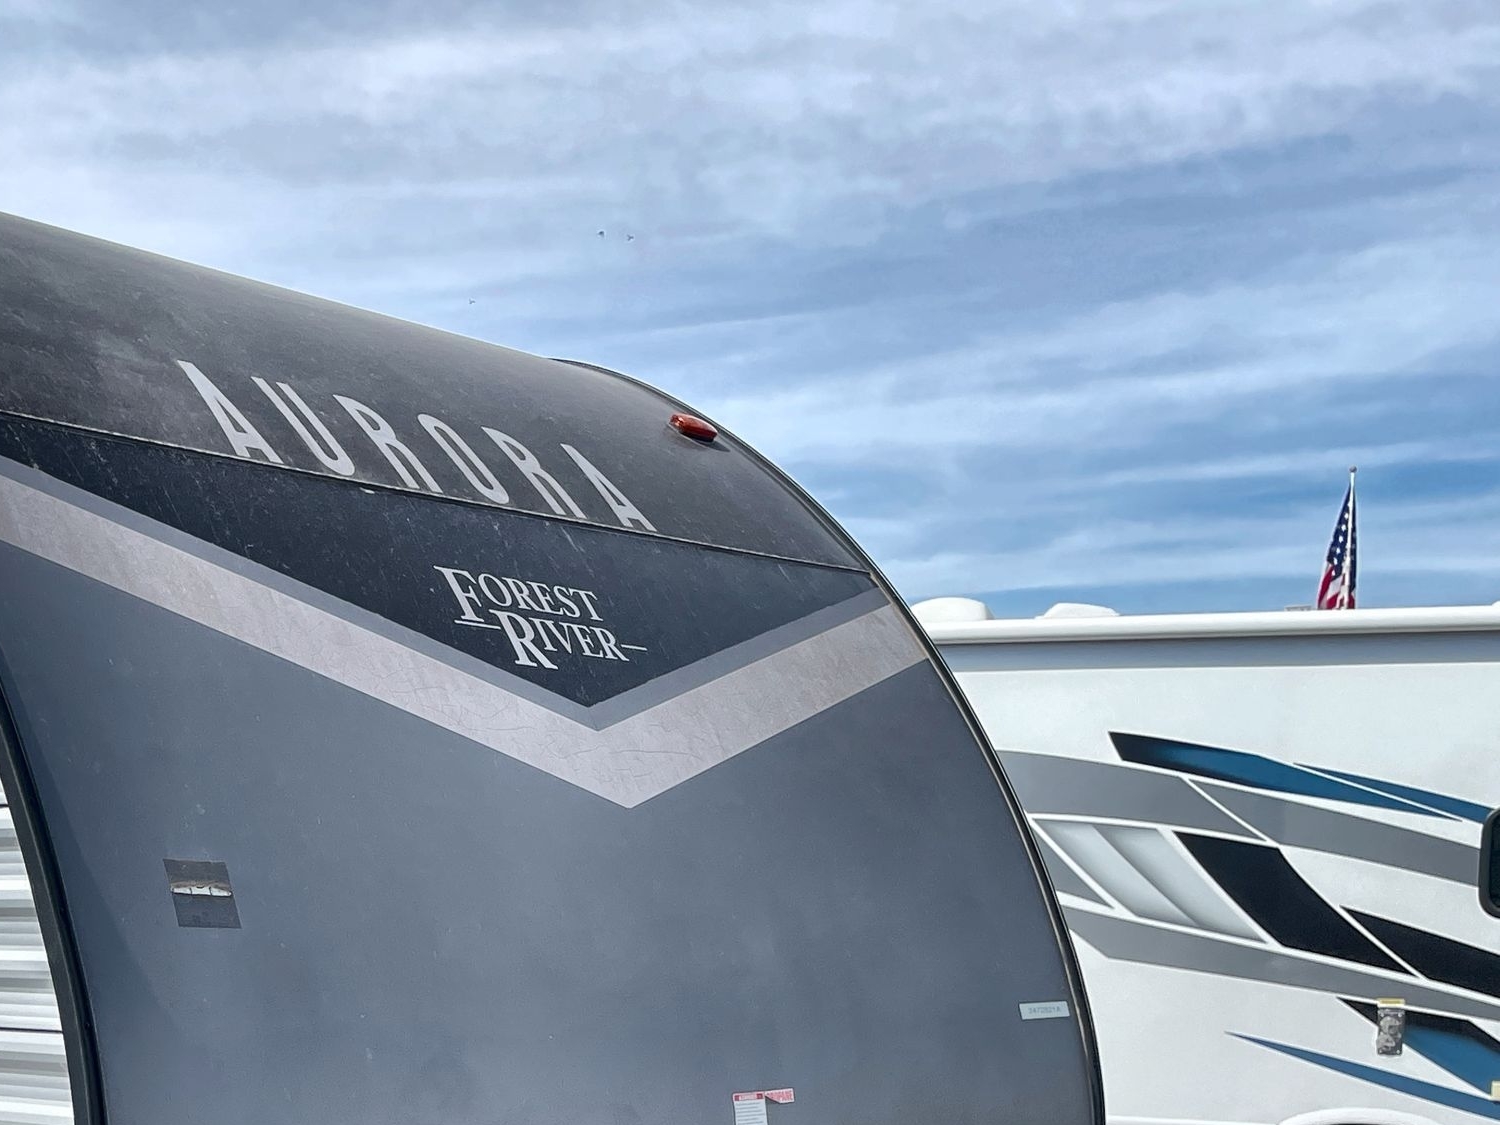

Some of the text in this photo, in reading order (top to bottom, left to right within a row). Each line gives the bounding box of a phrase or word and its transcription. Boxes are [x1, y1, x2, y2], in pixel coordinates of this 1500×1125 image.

[177, 359, 658, 533] AURORA
[433, 564, 604, 623] FOREST
[488, 608, 630, 671] RIVER
